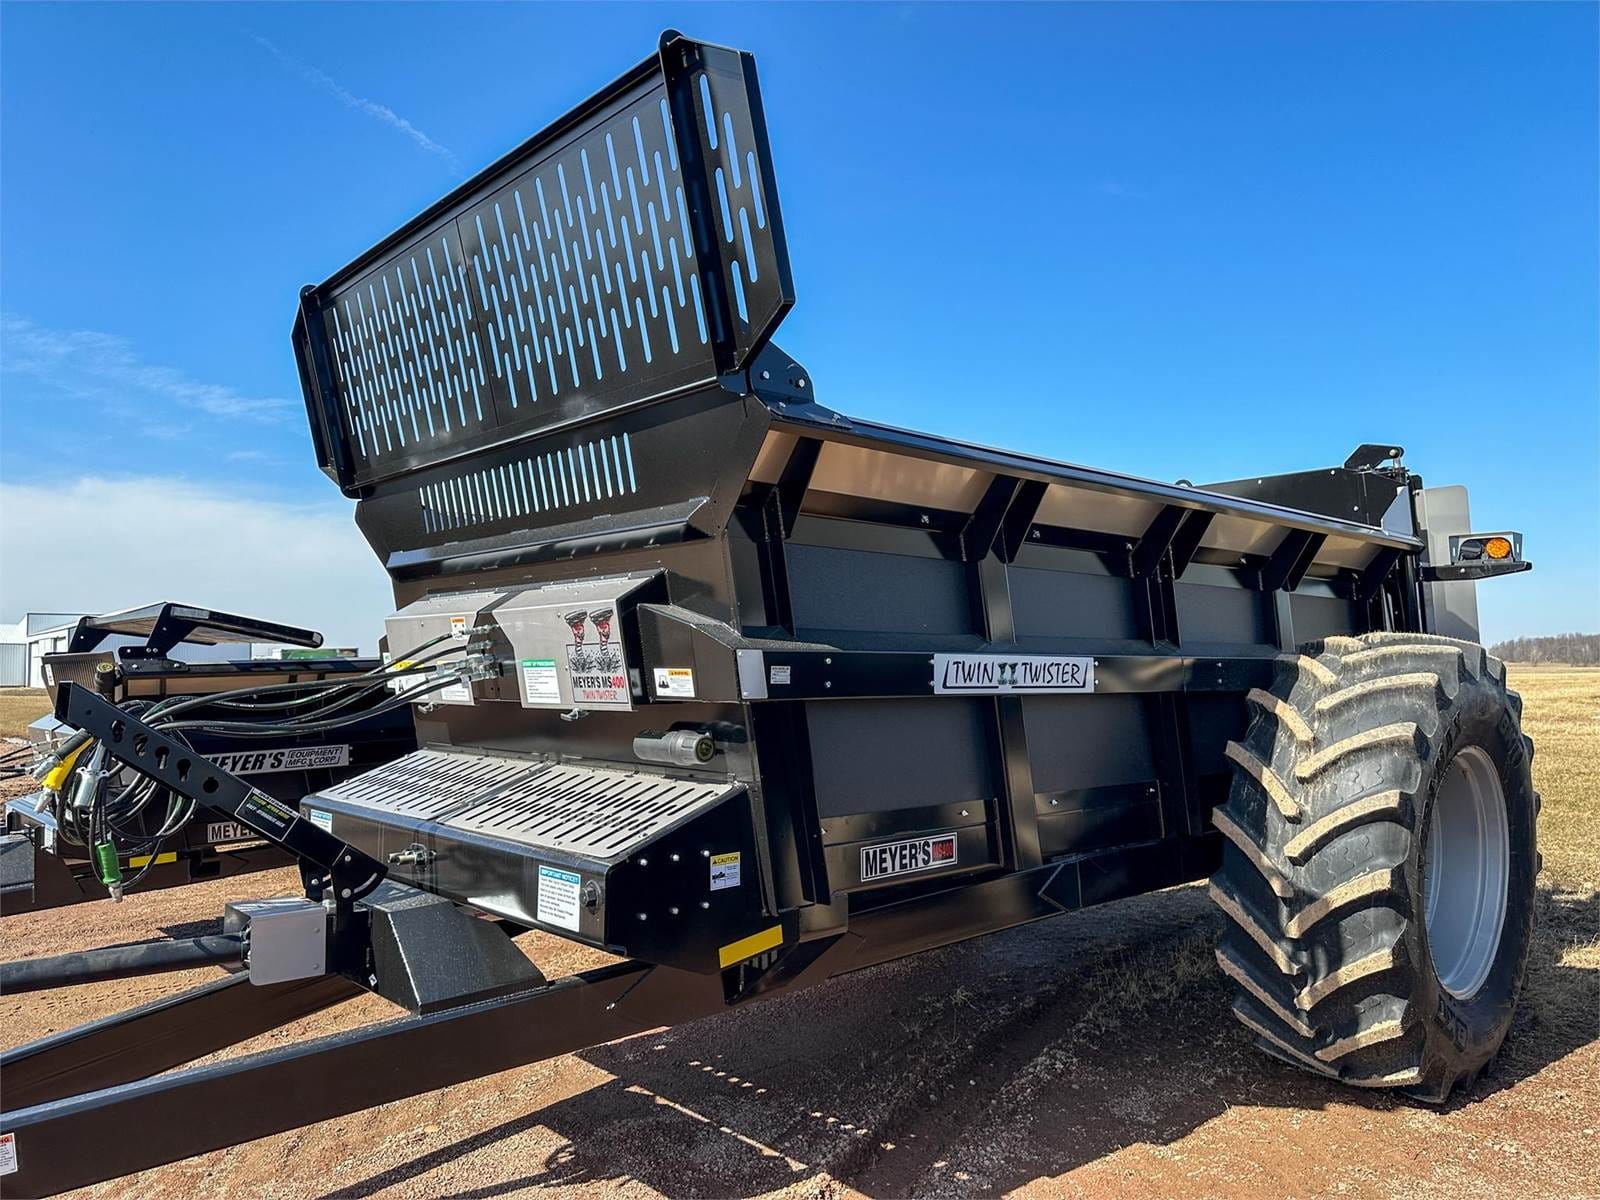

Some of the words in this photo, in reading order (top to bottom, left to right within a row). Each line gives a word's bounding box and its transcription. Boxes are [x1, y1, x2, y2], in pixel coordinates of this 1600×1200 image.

[953, 661, 995, 684] TWIN
[1022, 662, 1081, 685] TWISTER
[573, 676, 601, 688] MEYER'S
[602, 676, 624, 688] MS400
[290, 748, 340, 758] EQUIPMENT
[718, 855, 739, 863] CAUTION
[864, 841, 931, 876] MEYER'S
